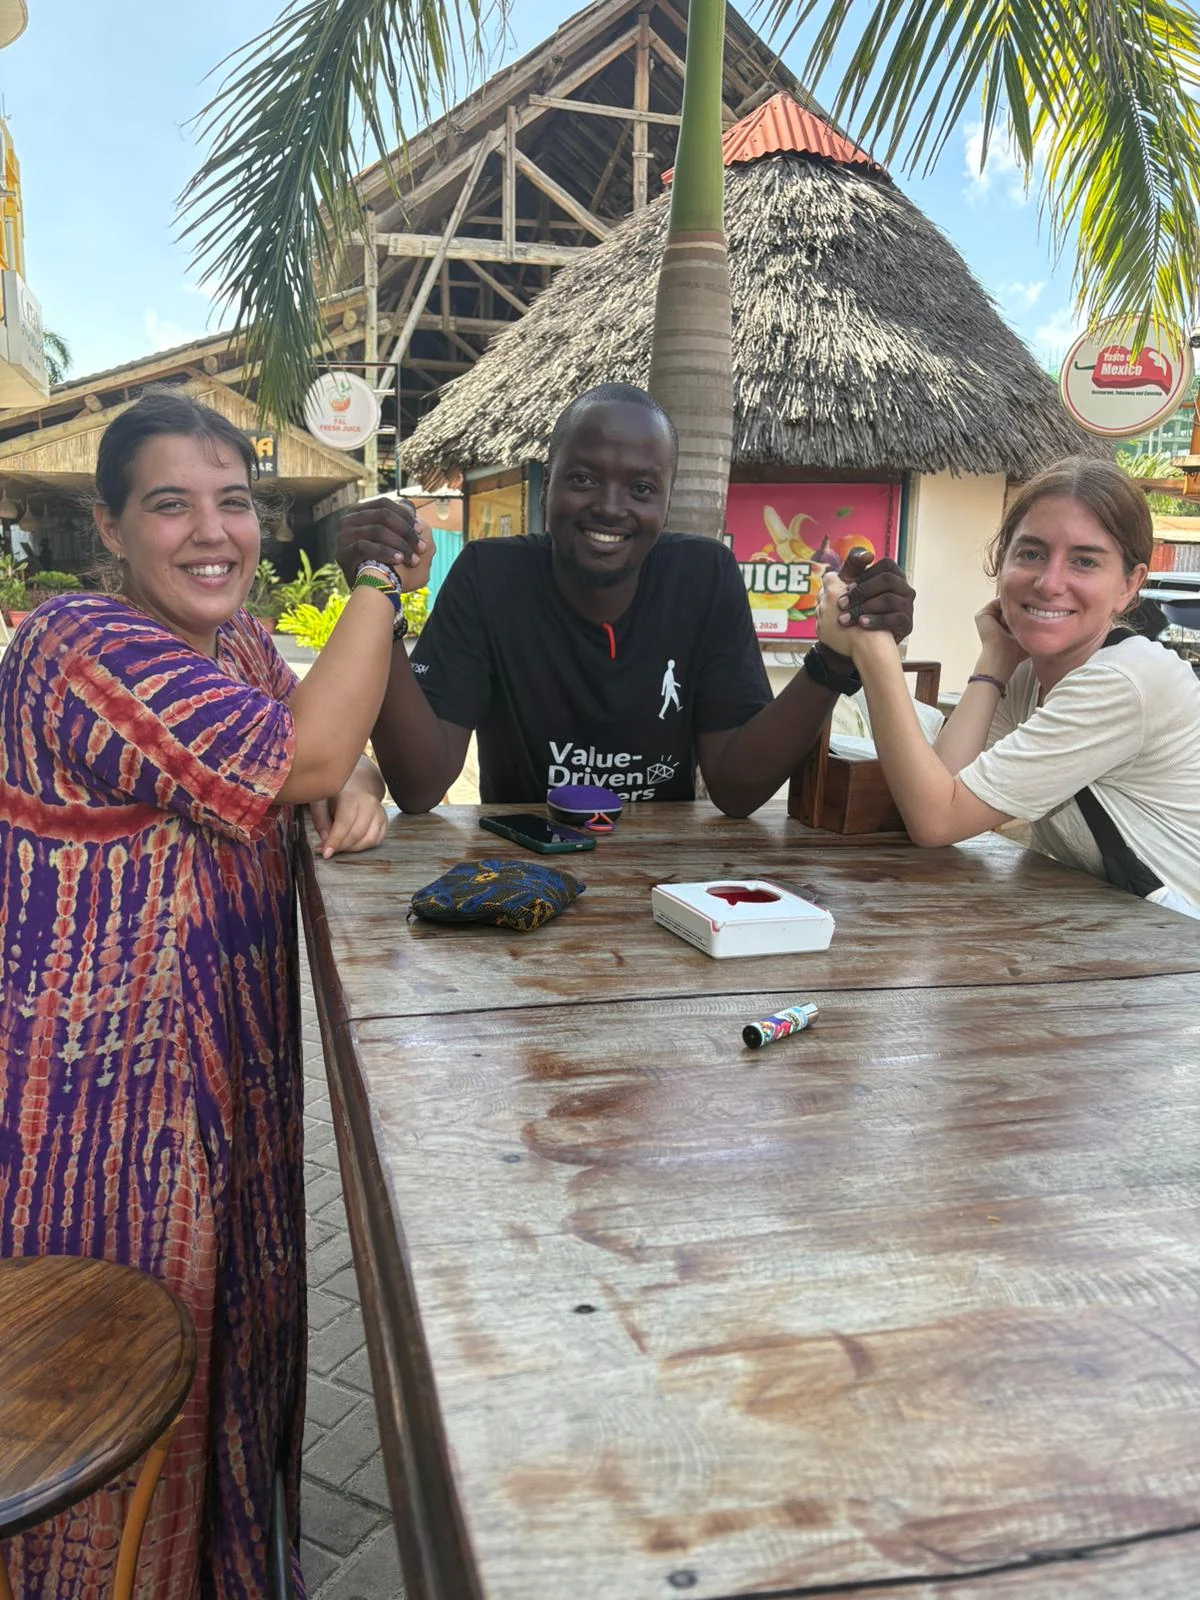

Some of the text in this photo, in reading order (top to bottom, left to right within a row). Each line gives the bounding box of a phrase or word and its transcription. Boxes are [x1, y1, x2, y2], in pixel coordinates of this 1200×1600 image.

[1104, 353, 1125, 362] Taste
[1101, 363, 1143, 376] Mexico
[738, 562, 811, 594] UICE
[760, 622, 779, 630] 2026
[548, 741, 643, 768] Value-
[547, 766, 644, 788] Driven
